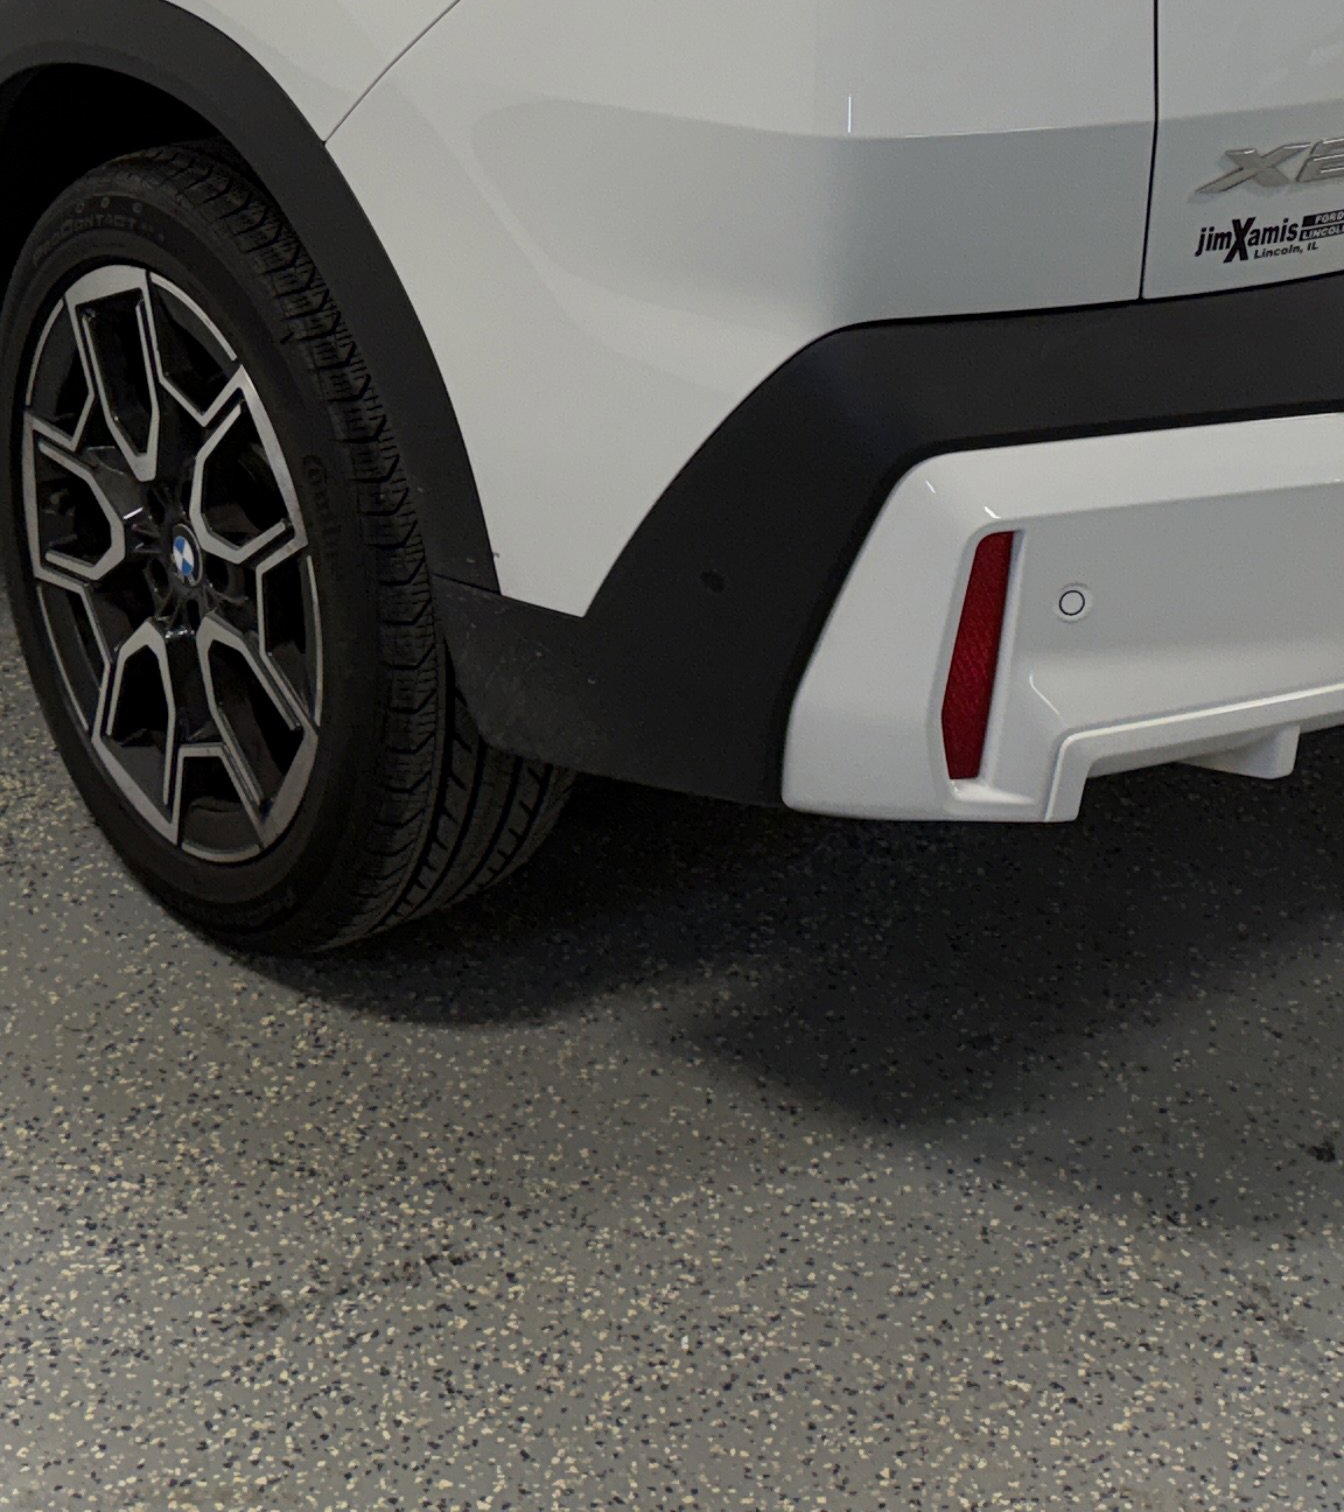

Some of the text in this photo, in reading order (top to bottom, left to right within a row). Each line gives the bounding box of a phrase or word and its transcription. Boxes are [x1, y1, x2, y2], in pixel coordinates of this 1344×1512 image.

[1314, 210, 1344, 224] FORD
[1253, 240, 1319, 260] Lincoln, IL
